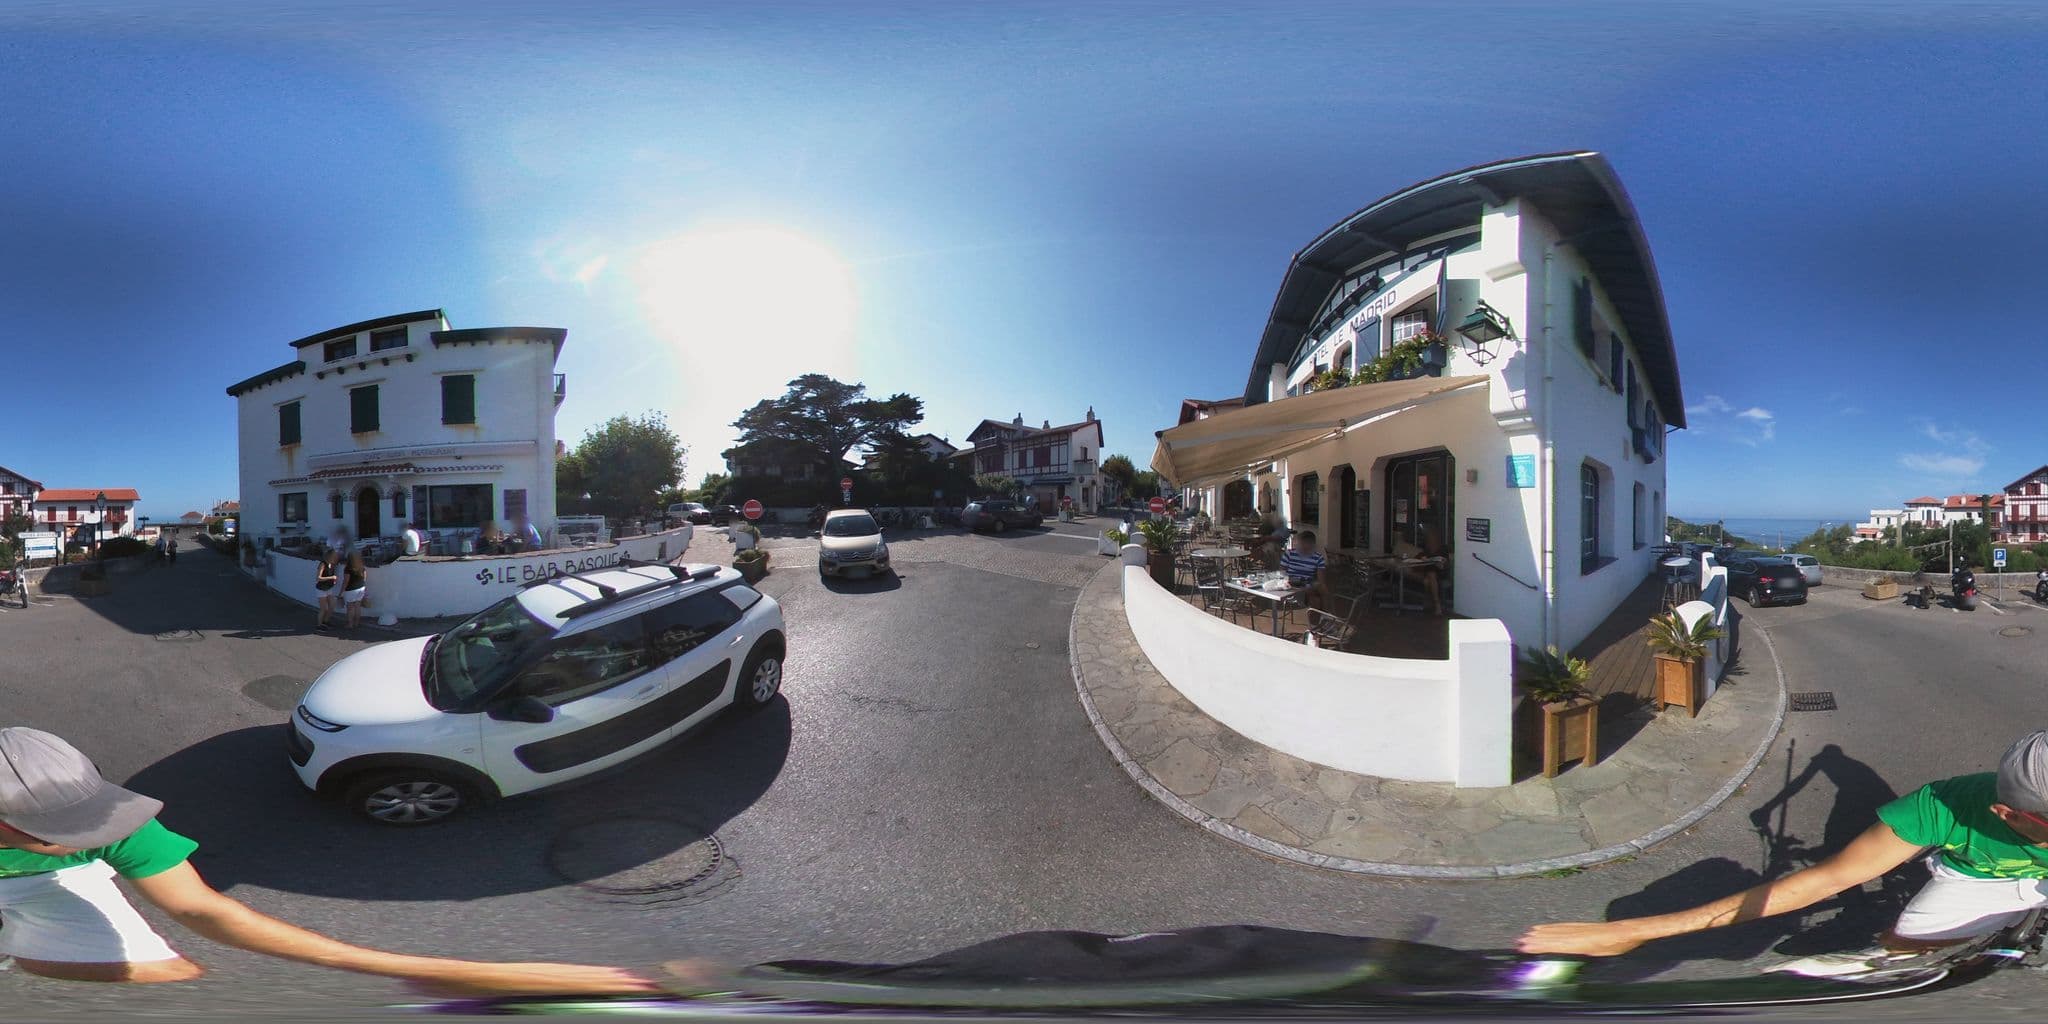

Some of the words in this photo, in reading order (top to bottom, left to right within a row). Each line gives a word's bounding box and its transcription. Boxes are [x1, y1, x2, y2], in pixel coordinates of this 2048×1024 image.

[1333, 329, 1344, 346] LE
[1349, 290, 1397, 334] MADRID
[497, 566, 516, 584] LE
[522, 562, 557, 581] BAB
[565, 552, 620, 574] BASQUE
